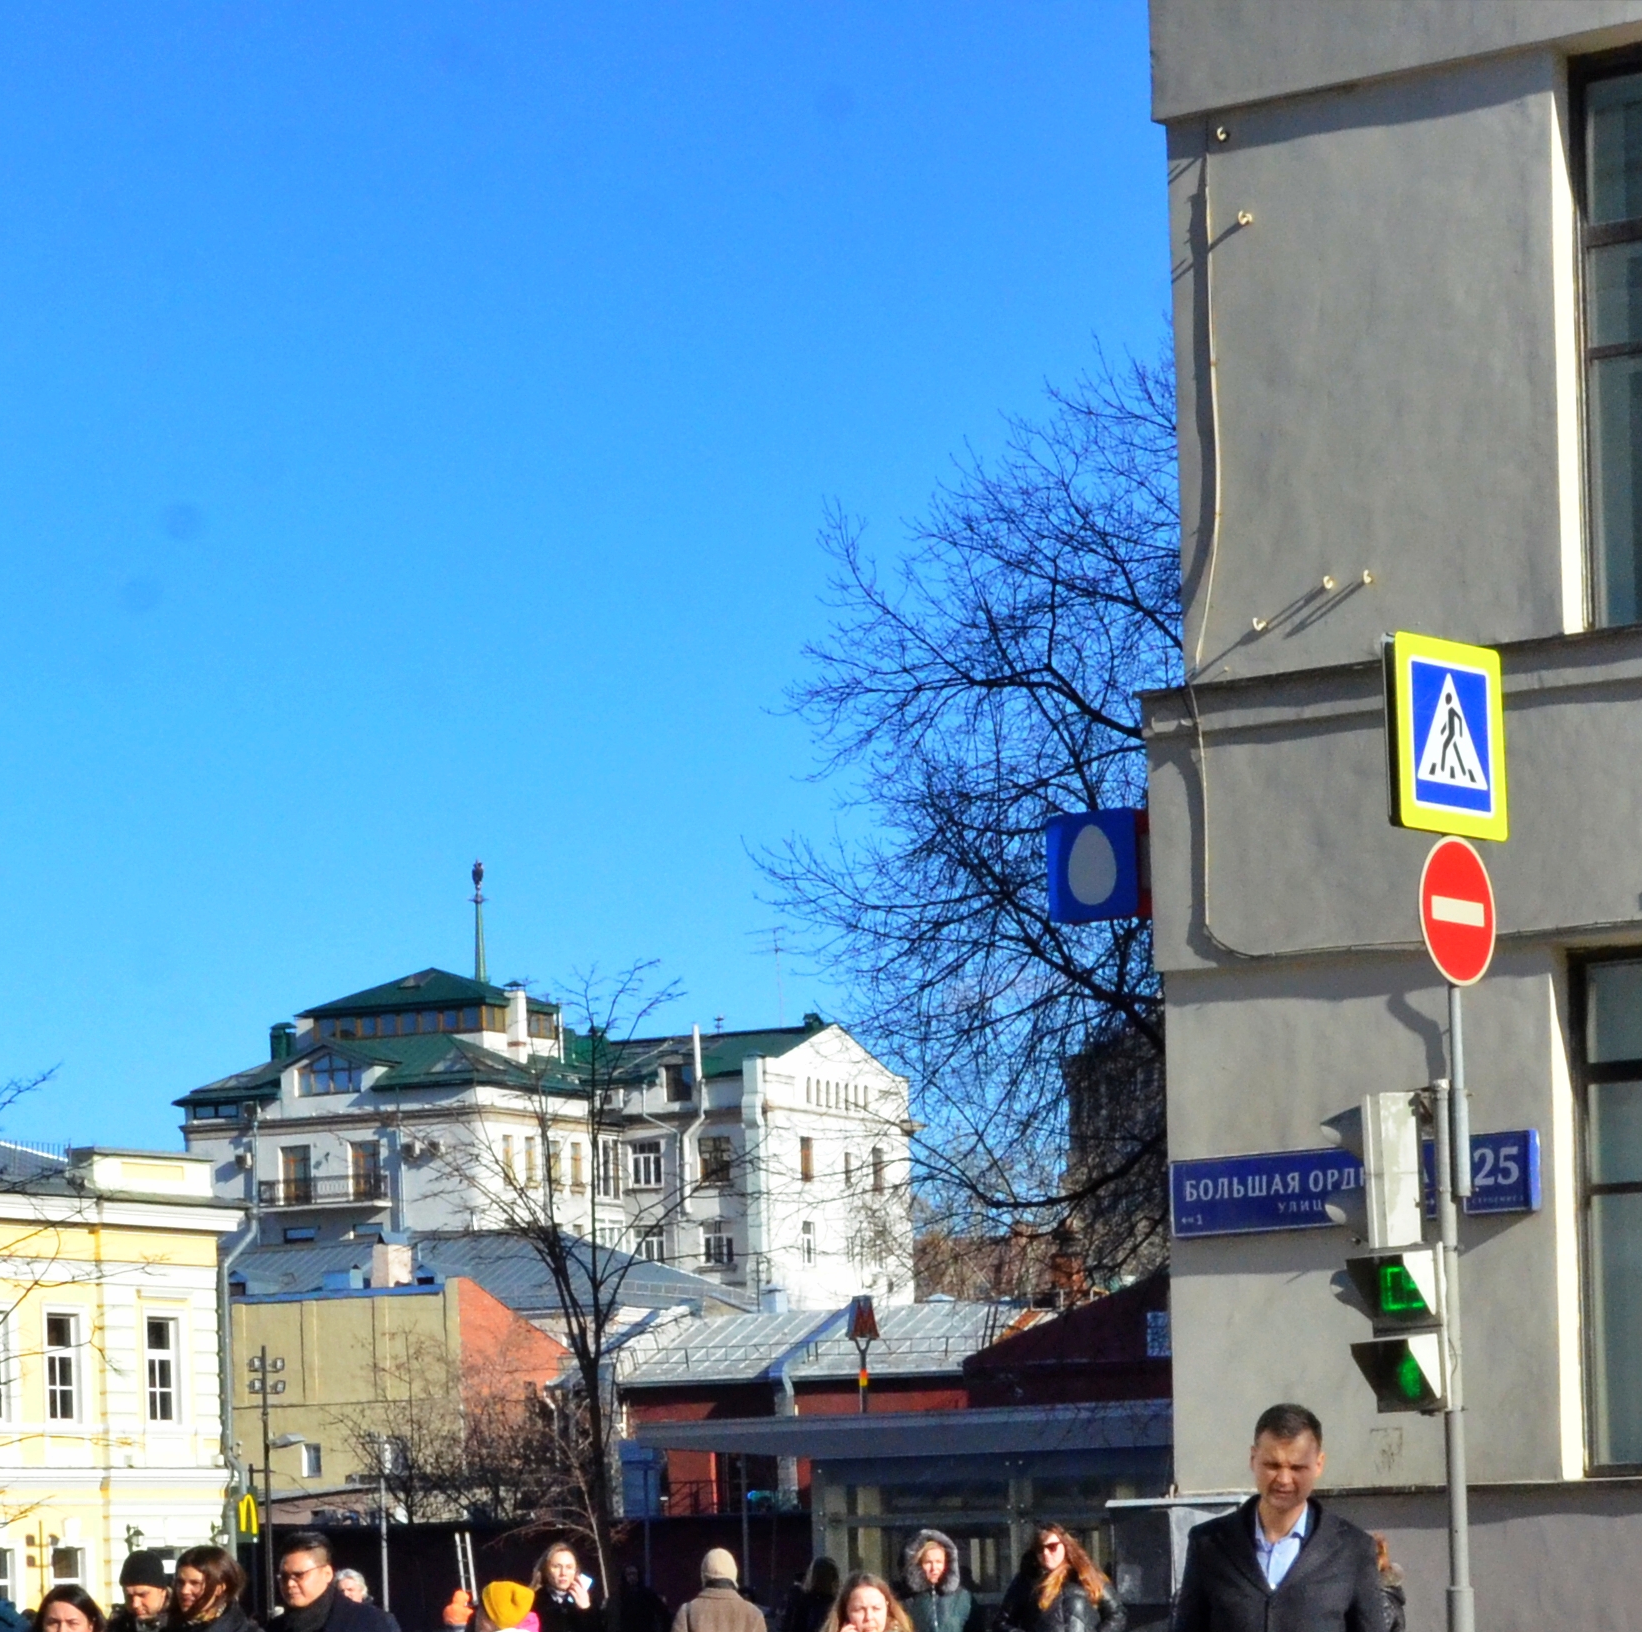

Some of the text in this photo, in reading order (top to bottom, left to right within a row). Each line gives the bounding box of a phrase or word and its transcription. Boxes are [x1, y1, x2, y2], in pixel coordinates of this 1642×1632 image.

[1473, 1146, 1520, 1186] 25
[1185, 1171, 1300, 1202] БОЛЬШАЯ
[1277, 1199, 1324, 1214] УЛИЦ
